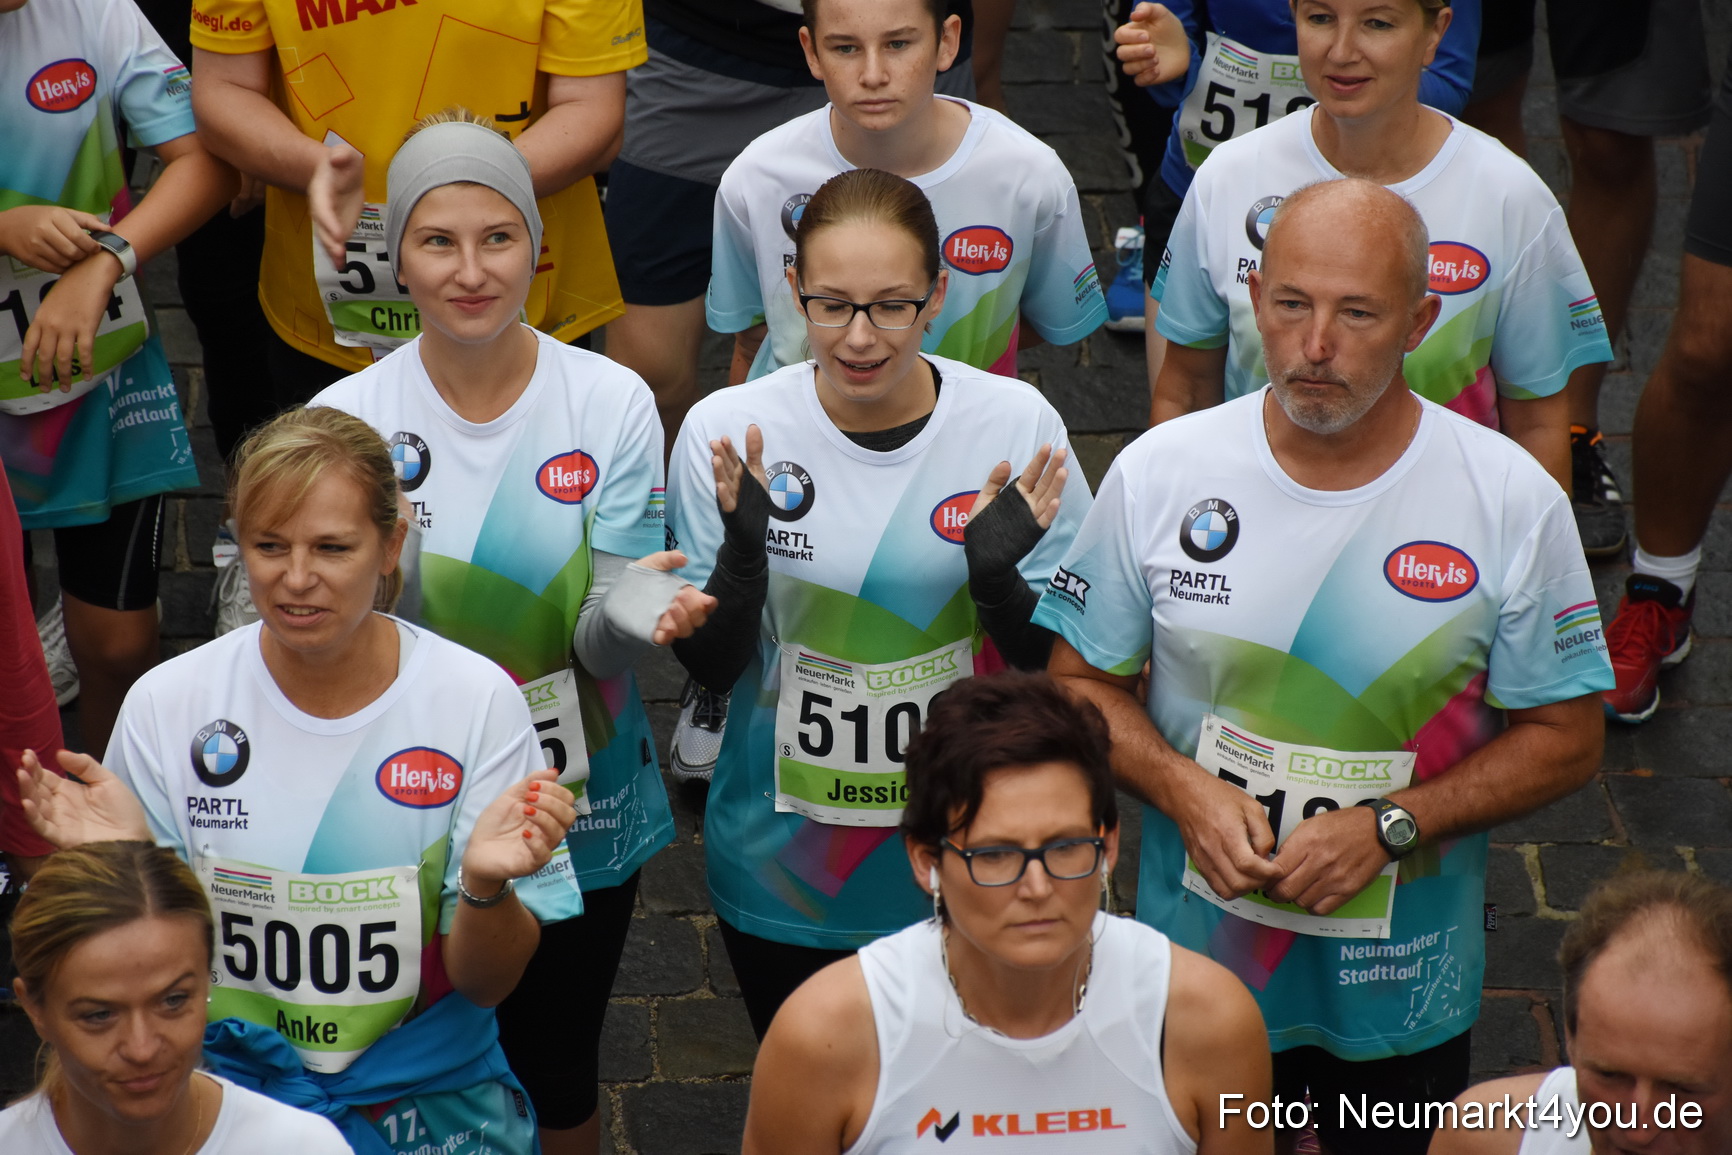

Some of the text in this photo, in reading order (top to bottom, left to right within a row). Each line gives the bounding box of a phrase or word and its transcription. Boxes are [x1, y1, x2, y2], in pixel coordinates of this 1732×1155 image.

[1213, 56, 1259, 80] NeuerMarkt
[35, 71, 90, 101] Hervis
[953, 238, 1008, 262] Hervis
[765, 462, 811, 485] BMW
[943, 506, 970, 528] He
[1188, 500, 1237, 522] BMW
[1170, 569, 1232, 592] PARTL
[1397, 553, 1468, 587] Hervis
[1169, 585, 1230, 605] Neumarkt
[1401, 579, 1436, 589] SPORTS
[1553, 628, 1601, 654] Neuer
[1561, 648, 1593, 663] einkaufen
[795, 664, 855, 689] NeuerMarkt
[866, 650, 958, 690] BOCK
[866, 670, 959, 699] inspired by smart concepts
[195, 721, 246, 744] BMW
[798, 689, 945, 764] 510
[783, 745, 791, 757] S
[1215, 739, 1275, 773] NeuerMarkt
[390, 763, 456, 793] Hervis
[1288, 752, 1394, 781] BOCK
[1286, 774, 1392, 790] inspired by smart concepts
[187, 796, 249, 816] PARTL
[187, 815, 249, 830] Neumarkt
[211, 883, 276, 904] NeuerMarkt
[288, 875, 399, 904] BOCK
[288, 904, 321, 913] inspired
[323, 905, 334, 914] by
[363, 902, 400, 911] concepts
[220, 911, 400, 995] 5005
[1340, 931, 1441, 961] Neumarkter
[1338, 957, 1424, 986] Stadtlauf
[1415, 973, 1443, 1020] September
[276, 1009, 338, 1044] Anke
[383, 1107, 426, 1145] 17.
[972, 1108, 1126, 1137] KLEBL
